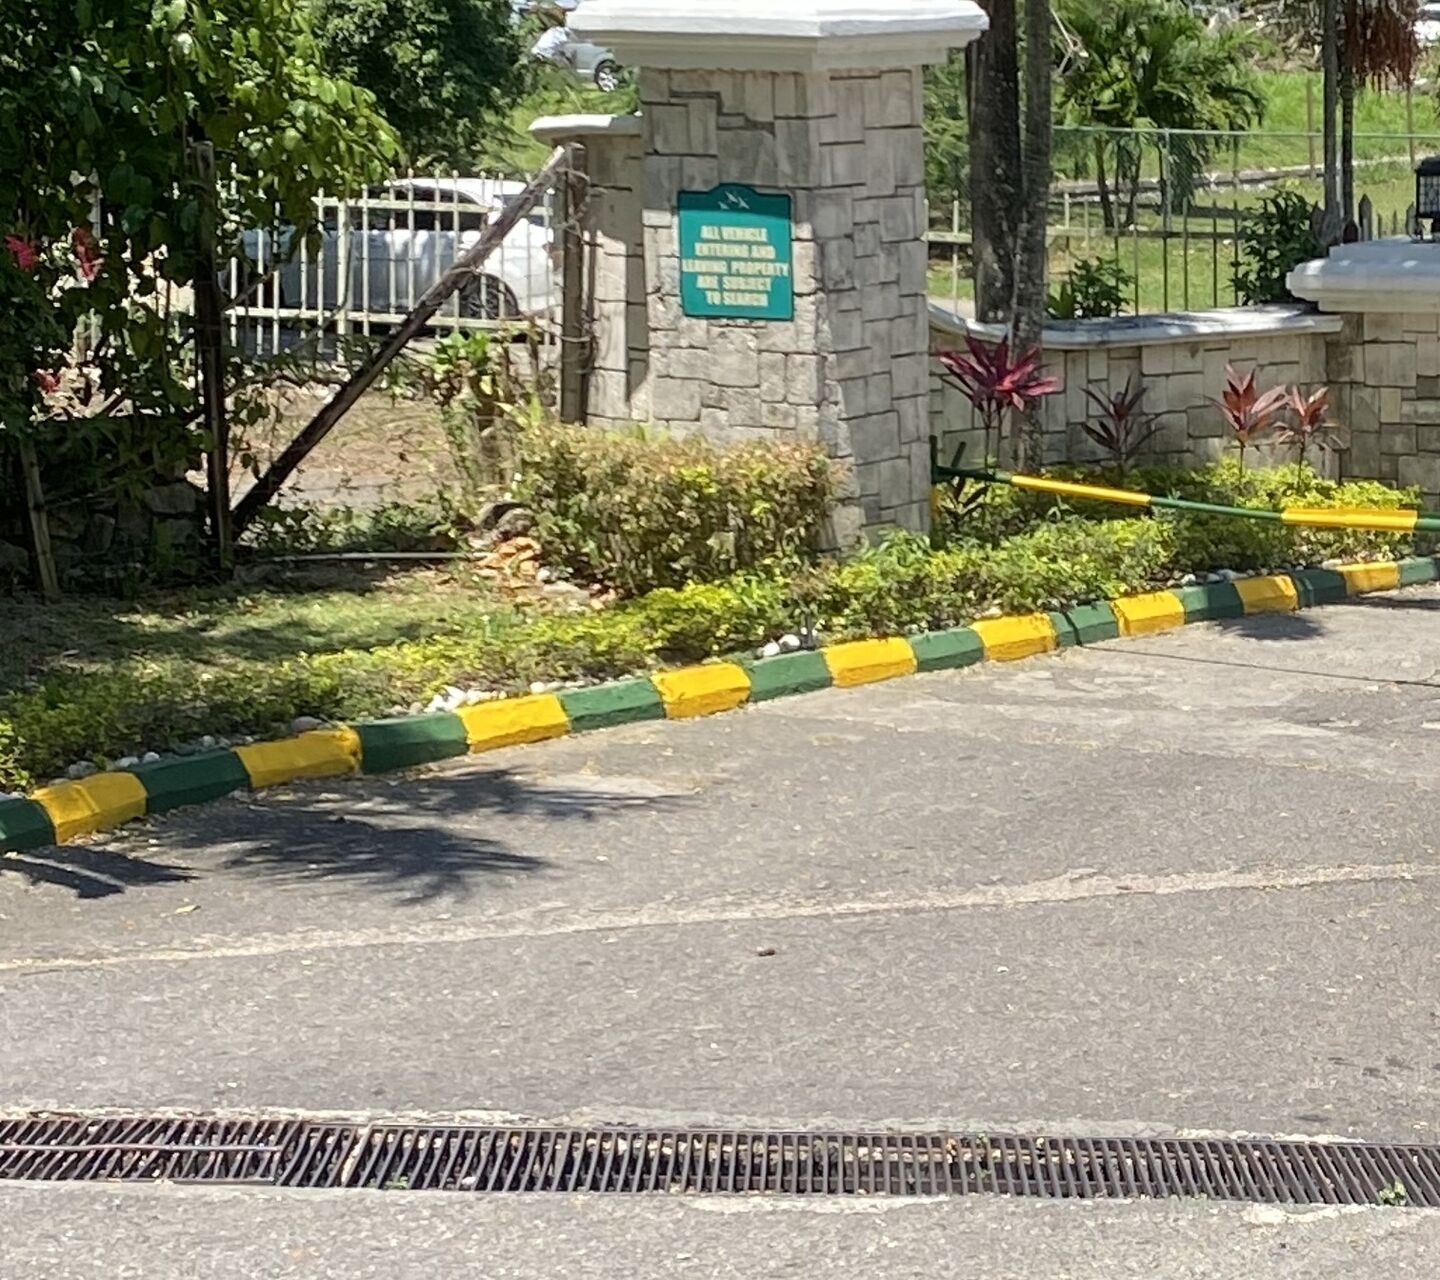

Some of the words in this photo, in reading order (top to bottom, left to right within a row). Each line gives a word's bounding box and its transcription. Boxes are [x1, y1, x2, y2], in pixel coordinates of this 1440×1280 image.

[701, 225, 720, 240] ALL
[695, 242, 749, 258] ENTERING
[751, 245, 776, 260] AND
[682, 259, 728, 274] LEAVING
[731, 260, 789, 276] PROPERTY
[697, 275, 719, 289] ARE
[722, 276, 771, 291] SUBJECT
[705, 291, 721, 305] TO
[722, 291, 768, 306] SEARCH
